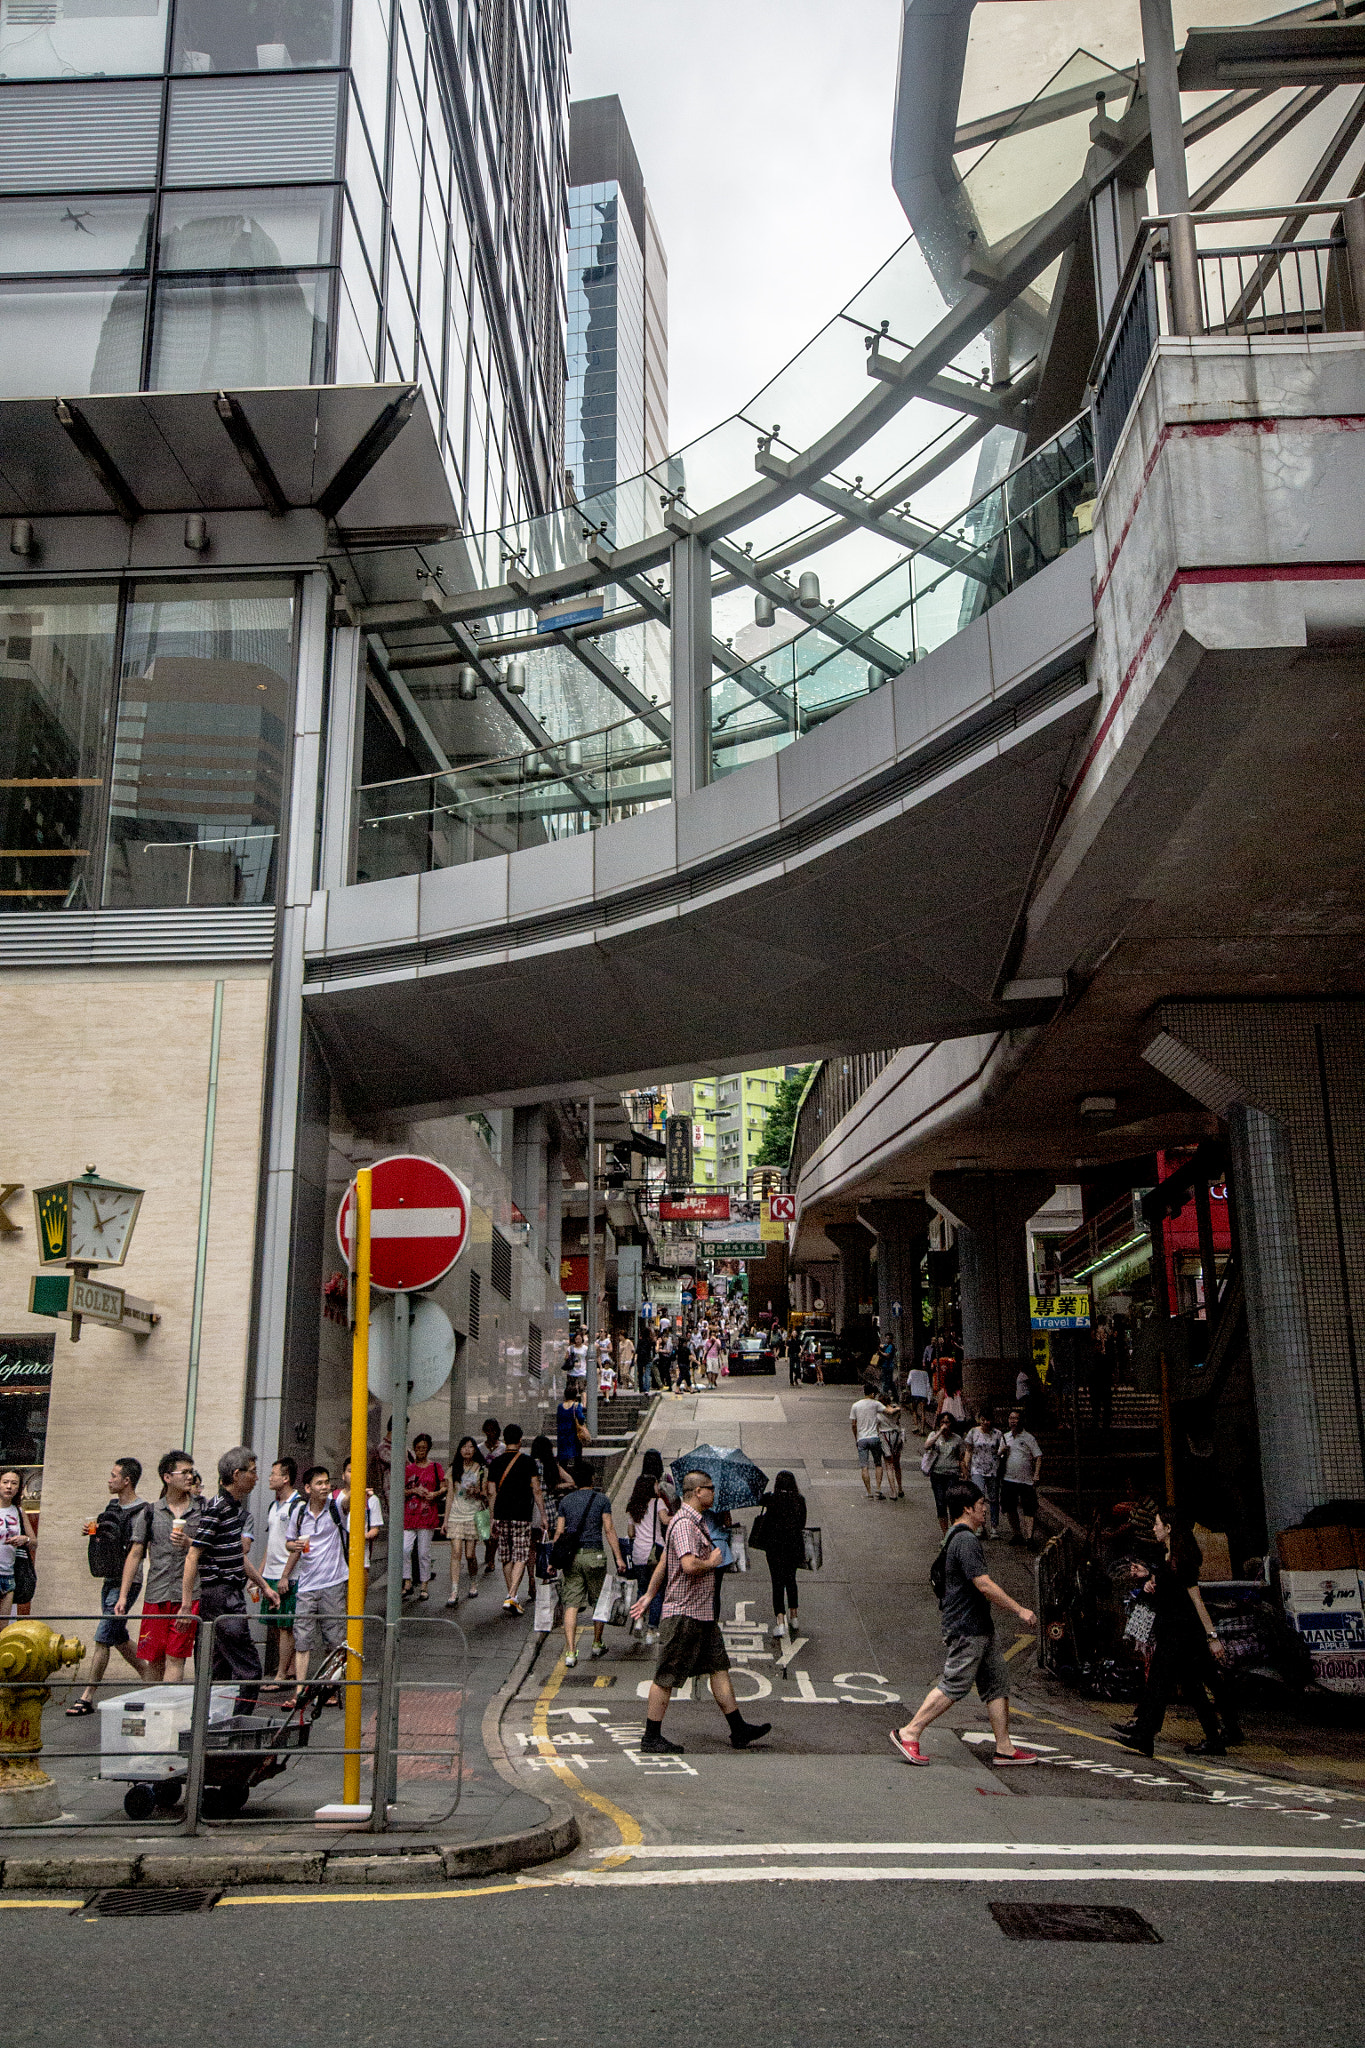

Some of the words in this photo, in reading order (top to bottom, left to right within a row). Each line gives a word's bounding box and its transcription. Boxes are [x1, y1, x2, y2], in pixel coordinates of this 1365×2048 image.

[75, 1286, 119, 1316] ROLEX
[1037, 1317, 1070, 1327] Travel
[1319, 1642, 1350, 1650] APPLES
[622, 1748, 699, 1776] LEFT
[1037, 1754, 1190, 1787] RIGHT
